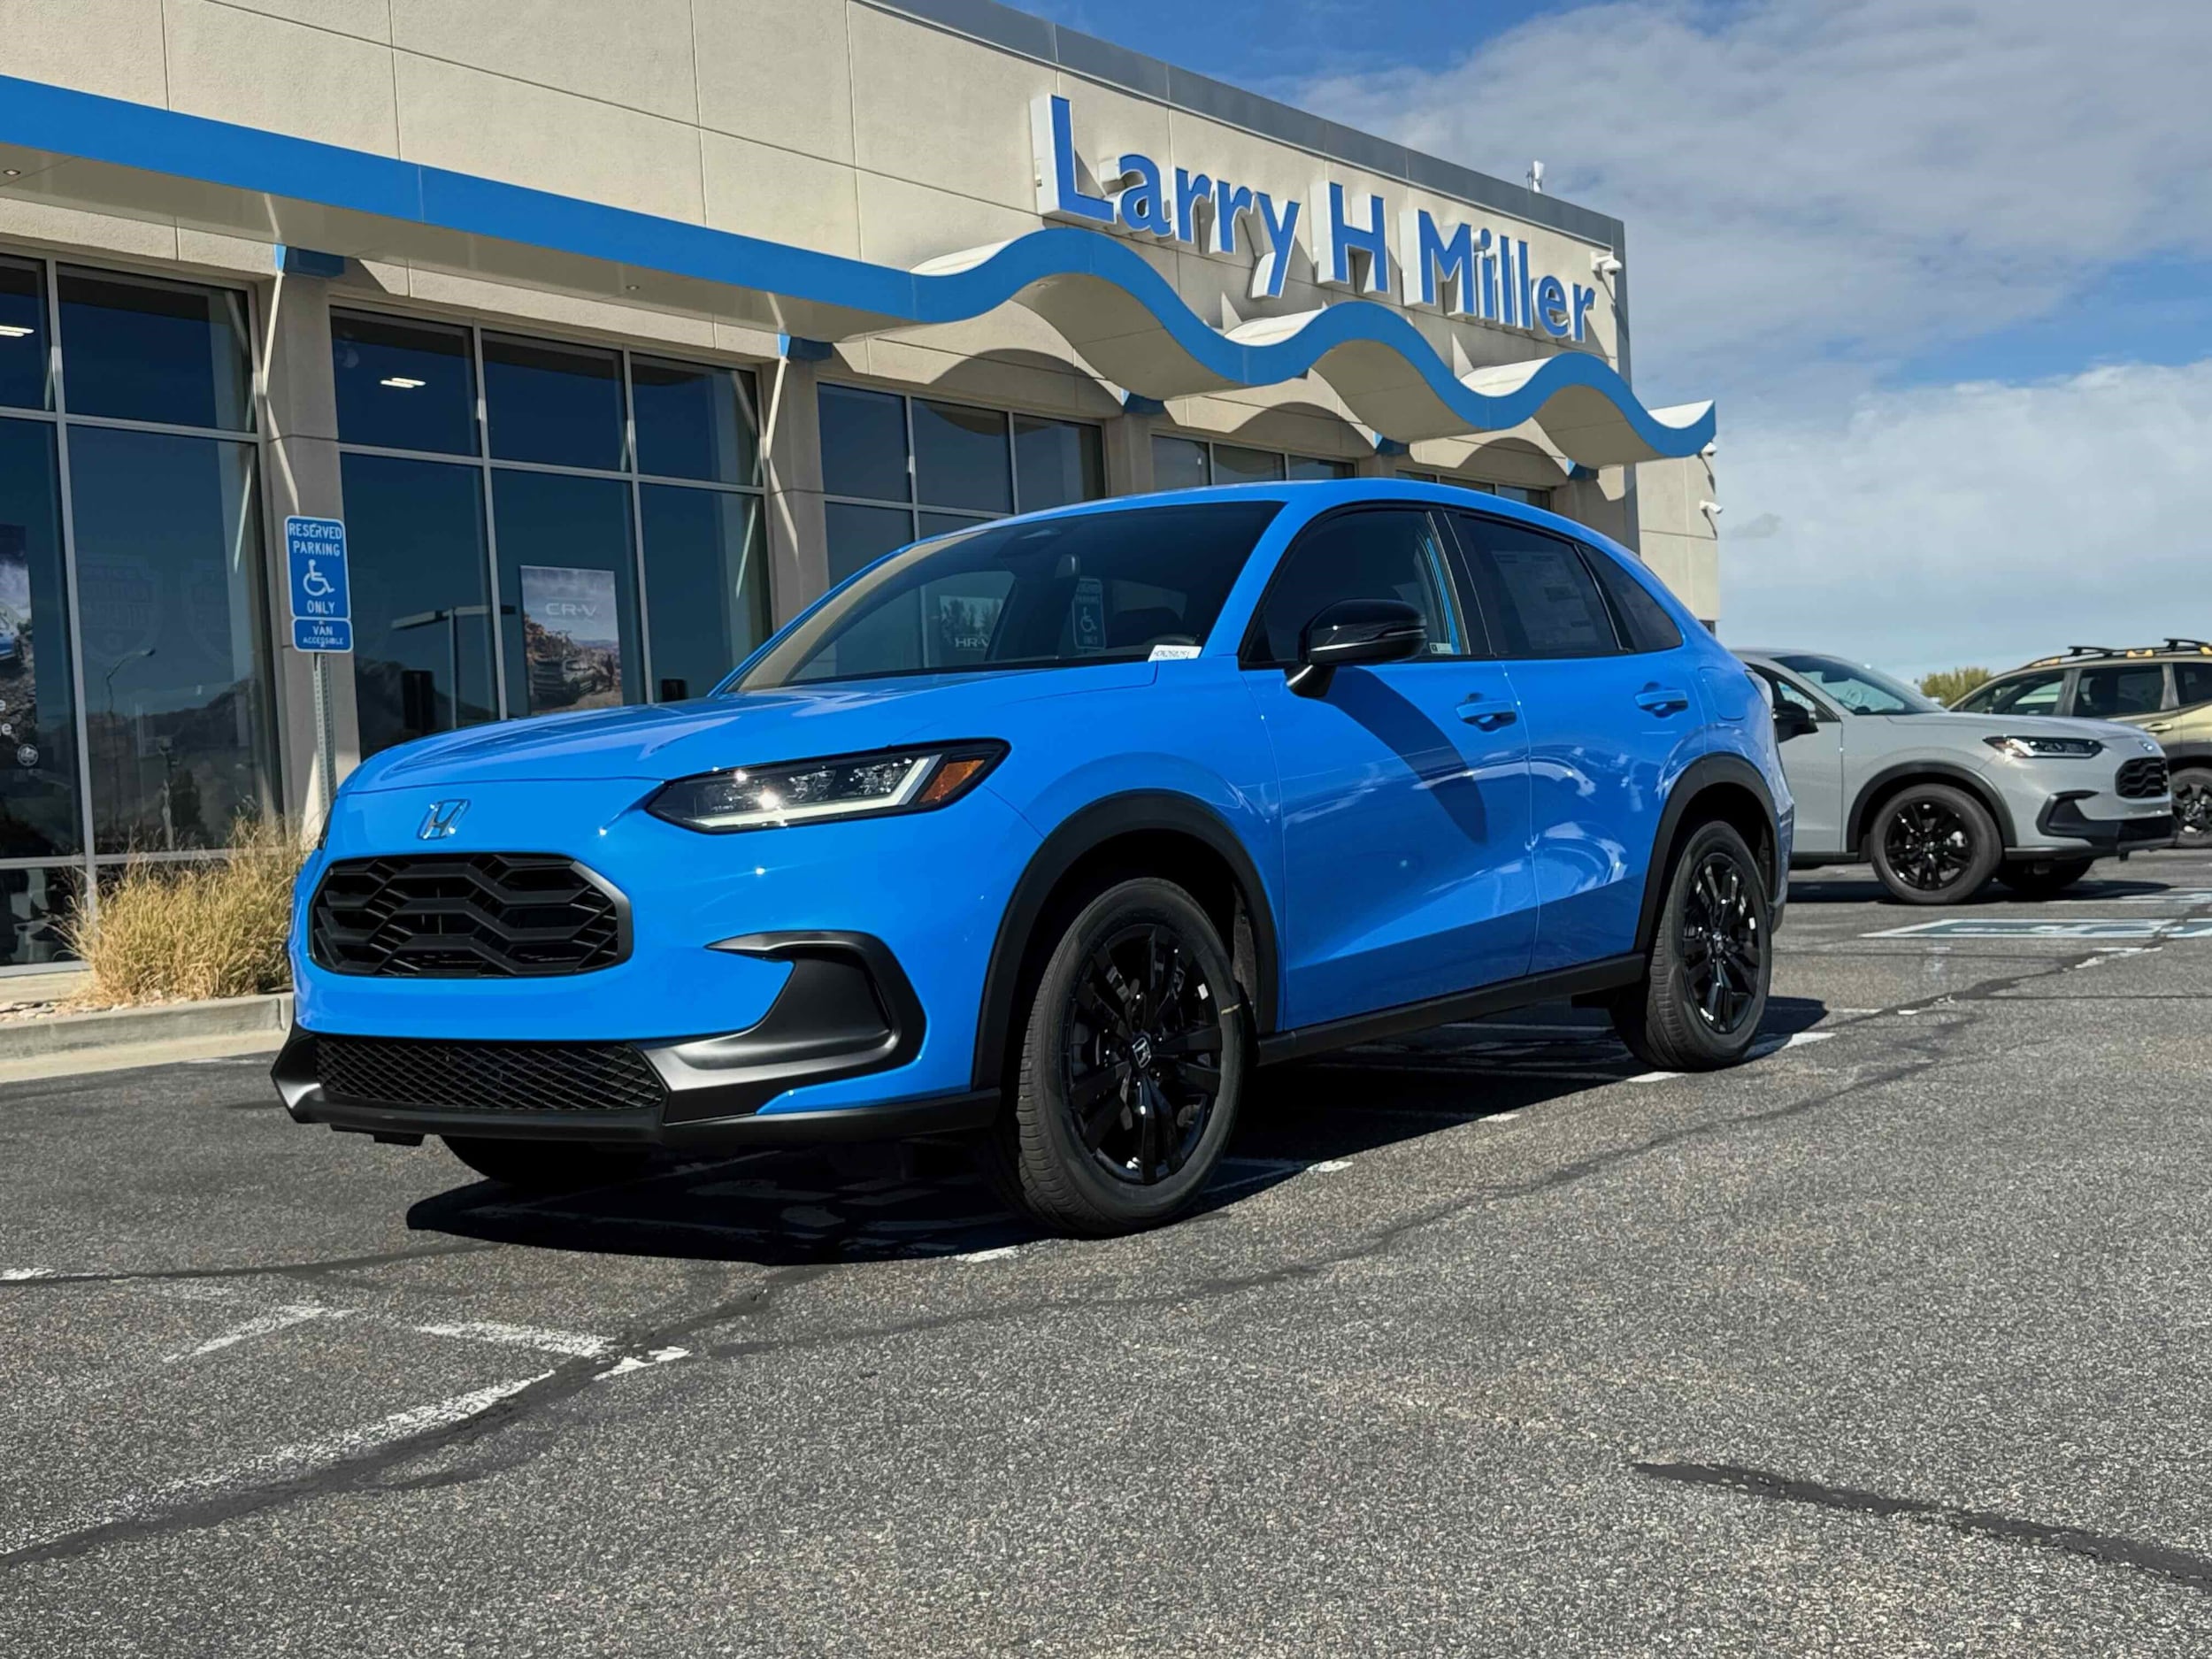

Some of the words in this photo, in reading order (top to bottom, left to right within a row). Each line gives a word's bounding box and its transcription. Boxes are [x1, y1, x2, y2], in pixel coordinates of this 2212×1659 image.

[1044, 94, 1302, 298] Larry
[1327, 181, 1391, 294] H
[1414, 207, 1596, 343] Miller
[288, 522, 342, 540] RESERVED
[292, 540, 341, 557] PARKING
[306, 600, 336, 615] ONLY
[545, 603, 597, 617] CR-V
[311, 625, 334, 636] VAN
[303, 636, 344, 646] ACCESSIBLE
